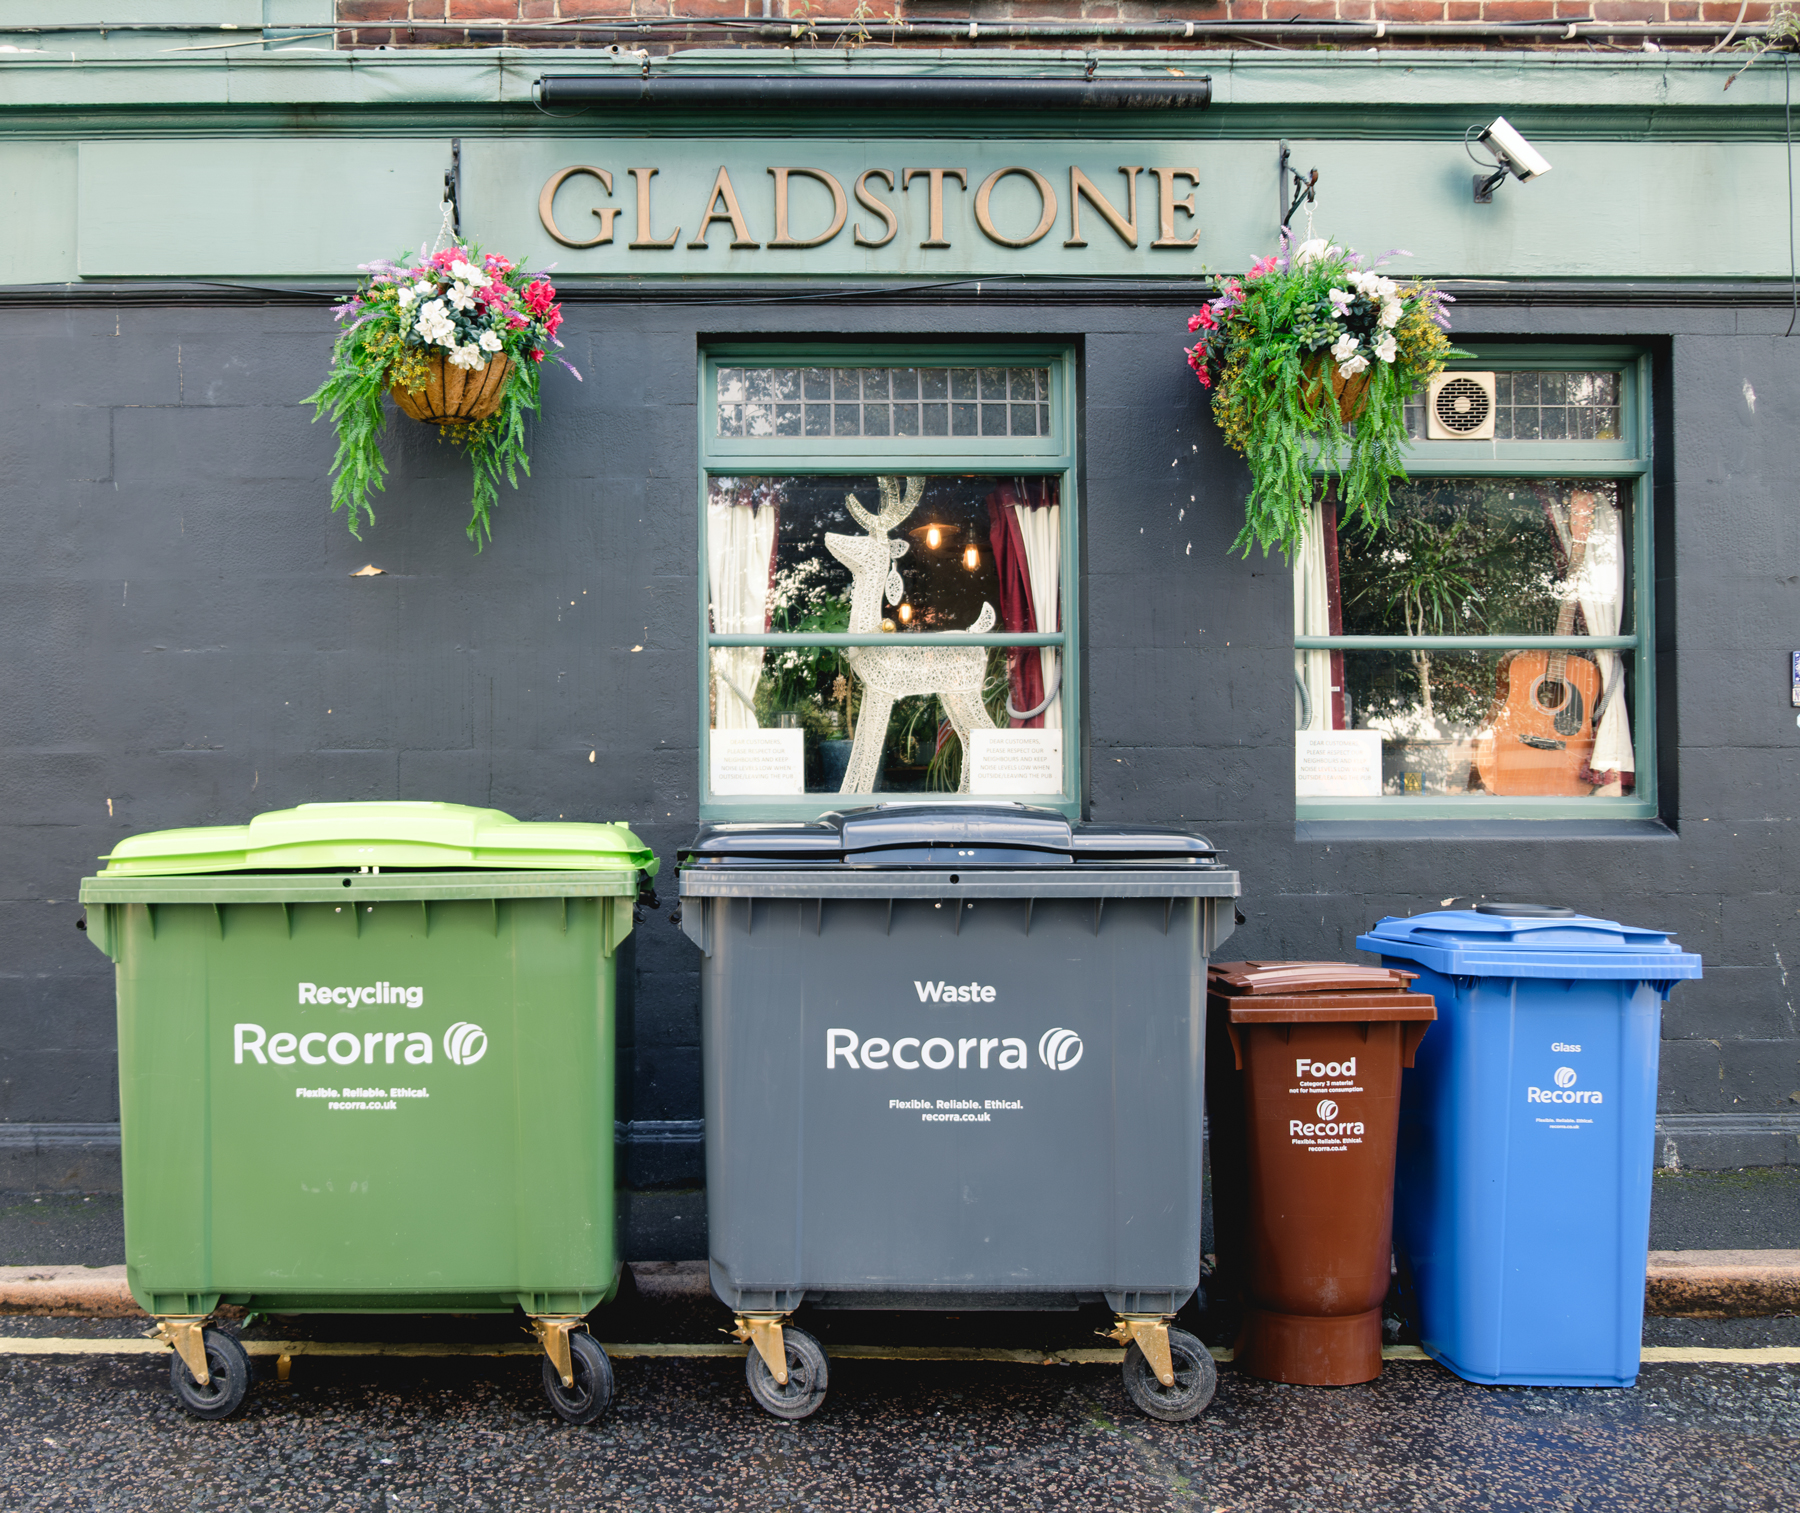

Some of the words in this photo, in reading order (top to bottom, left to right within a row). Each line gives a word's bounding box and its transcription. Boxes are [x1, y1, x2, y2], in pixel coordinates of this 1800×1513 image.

[537, 165, 1202, 250] GLADSTONE
[298, 981, 423, 1008] Recycling
[914, 981, 997, 1002] Waste
[234, 1023, 433, 1065] Recorra
[827, 1028, 1027, 1070] Recorra
[1551, 1042, 1581, 1052] Glass
[1296, 1057, 1356, 1077] Food
[296, 1088, 340, 1098] Flexible.
[343, 1088, 387, 1098] Reliable.
[390, 1088, 429, 1098] Ethical.
[1528, 1087, 1602, 1103] Recorra
[329, 1100, 397, 1110] recorra.co.uk
[889, 1100, 933, 1109] Flexible.
[936, 1100, 981, 1109] Reliable.
[985, 1100, 1023, 1109] Ethical.
[922, 1112, 991, 1122] recorra.co.uk
[1290, 1120, 1364, 1136] Recorra
